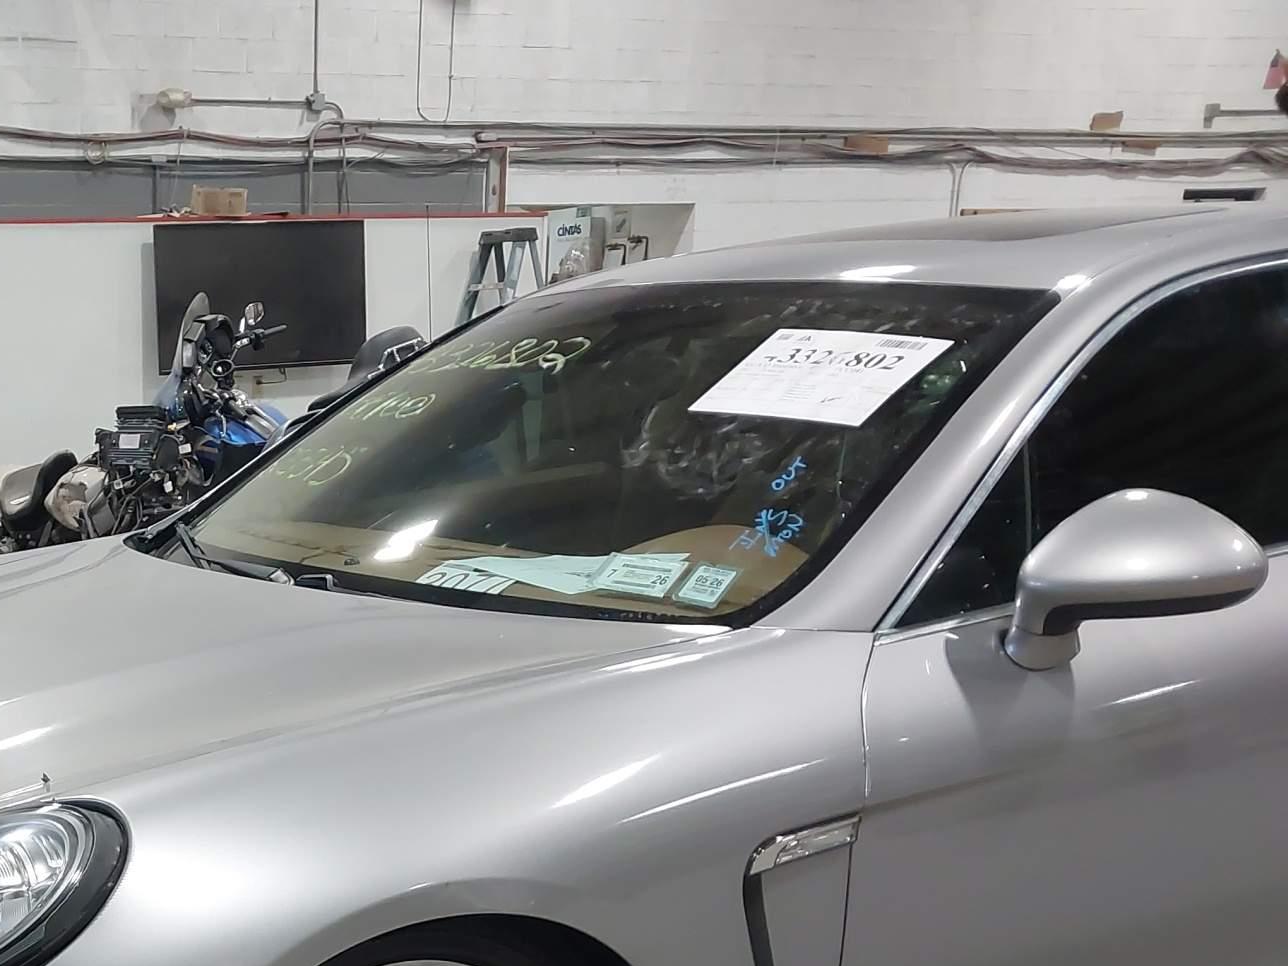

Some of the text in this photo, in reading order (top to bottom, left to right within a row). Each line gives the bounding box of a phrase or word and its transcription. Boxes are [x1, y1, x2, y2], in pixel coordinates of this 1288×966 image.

[651, 575, 669, 586] 26
[696, 575, 725, 587] 05 26
